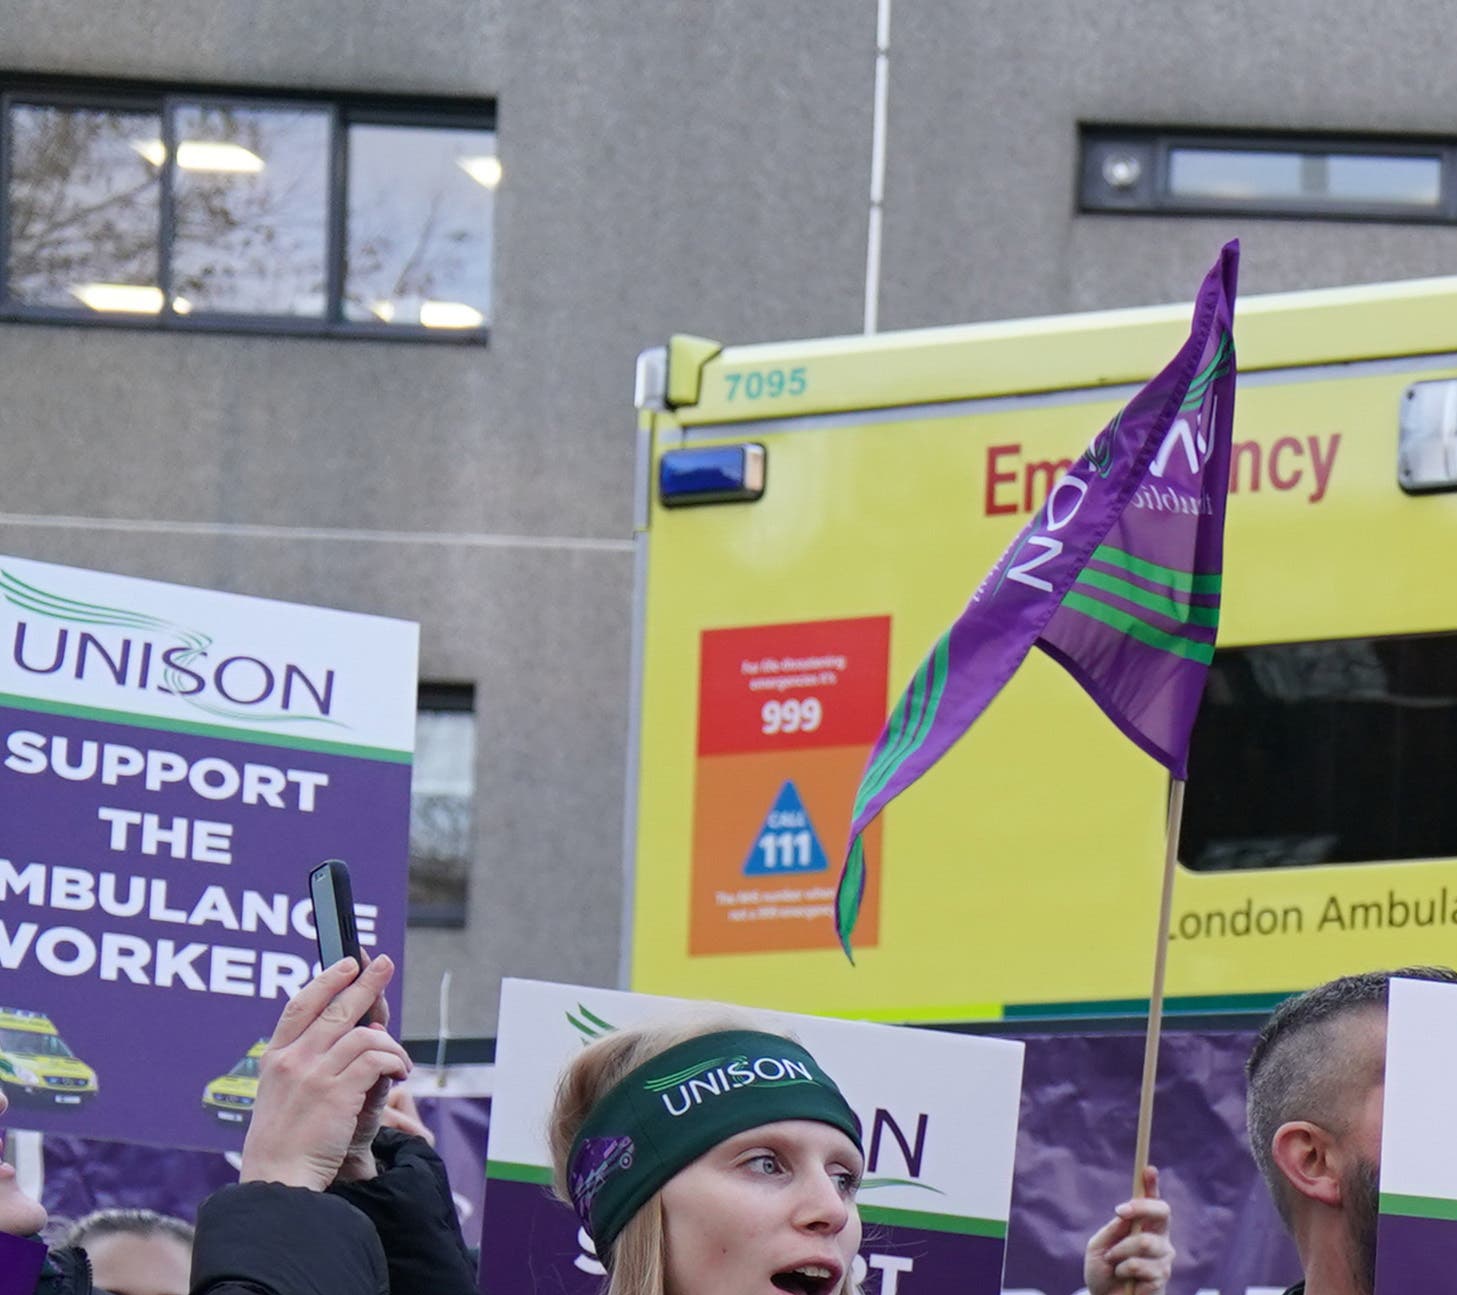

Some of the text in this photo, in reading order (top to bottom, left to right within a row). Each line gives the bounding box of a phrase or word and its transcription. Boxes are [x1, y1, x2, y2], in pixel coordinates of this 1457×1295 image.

[725, 367, 806, 400] 7095
[984, 434, 1340, 517] Emncy
[14, 622, 334, 715] UNISON
[761, 697, 823, 735] 999
[5, 730, 328, 812] SUPPORT
[98, 807, 233, 864] THE
[759, 830, 811, 868] 111
[662, 1057, 813, 1116] UNISON
